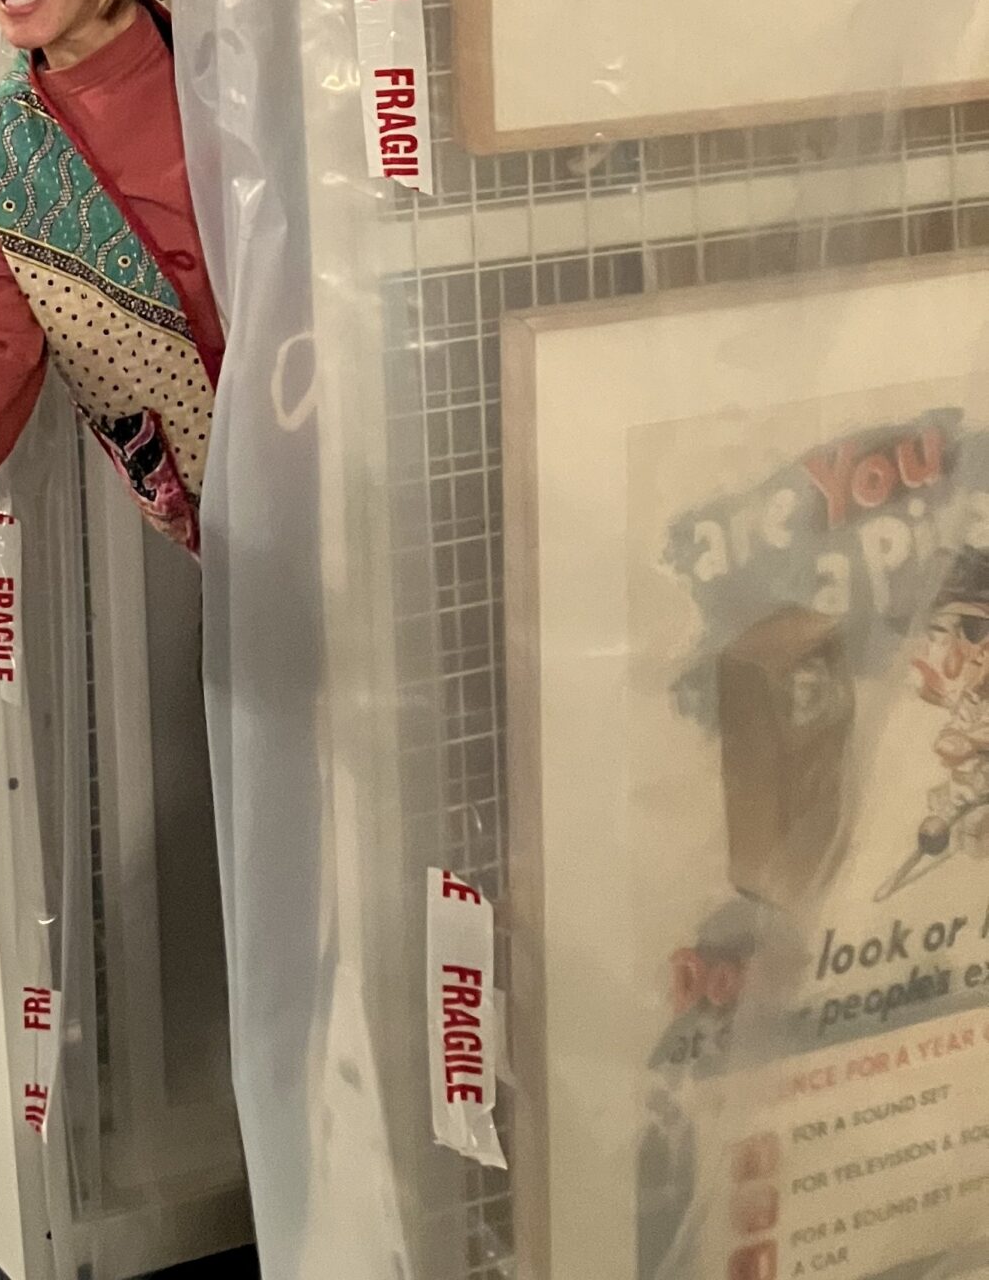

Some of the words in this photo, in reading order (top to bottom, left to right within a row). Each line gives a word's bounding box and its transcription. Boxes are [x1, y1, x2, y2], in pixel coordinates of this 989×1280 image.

[806, 427, 943, 528] You
[692, 488, 797, 582] are
[816, 919, 914, 980] look
[923, 916, 968, 952] or
[441, 963, 483, 1105] FRAGILE
[791, 1121, 828, 1144] FOR
[834, 1116, 847, 1133] A
[790, 1171, 829, 1195] FOR
